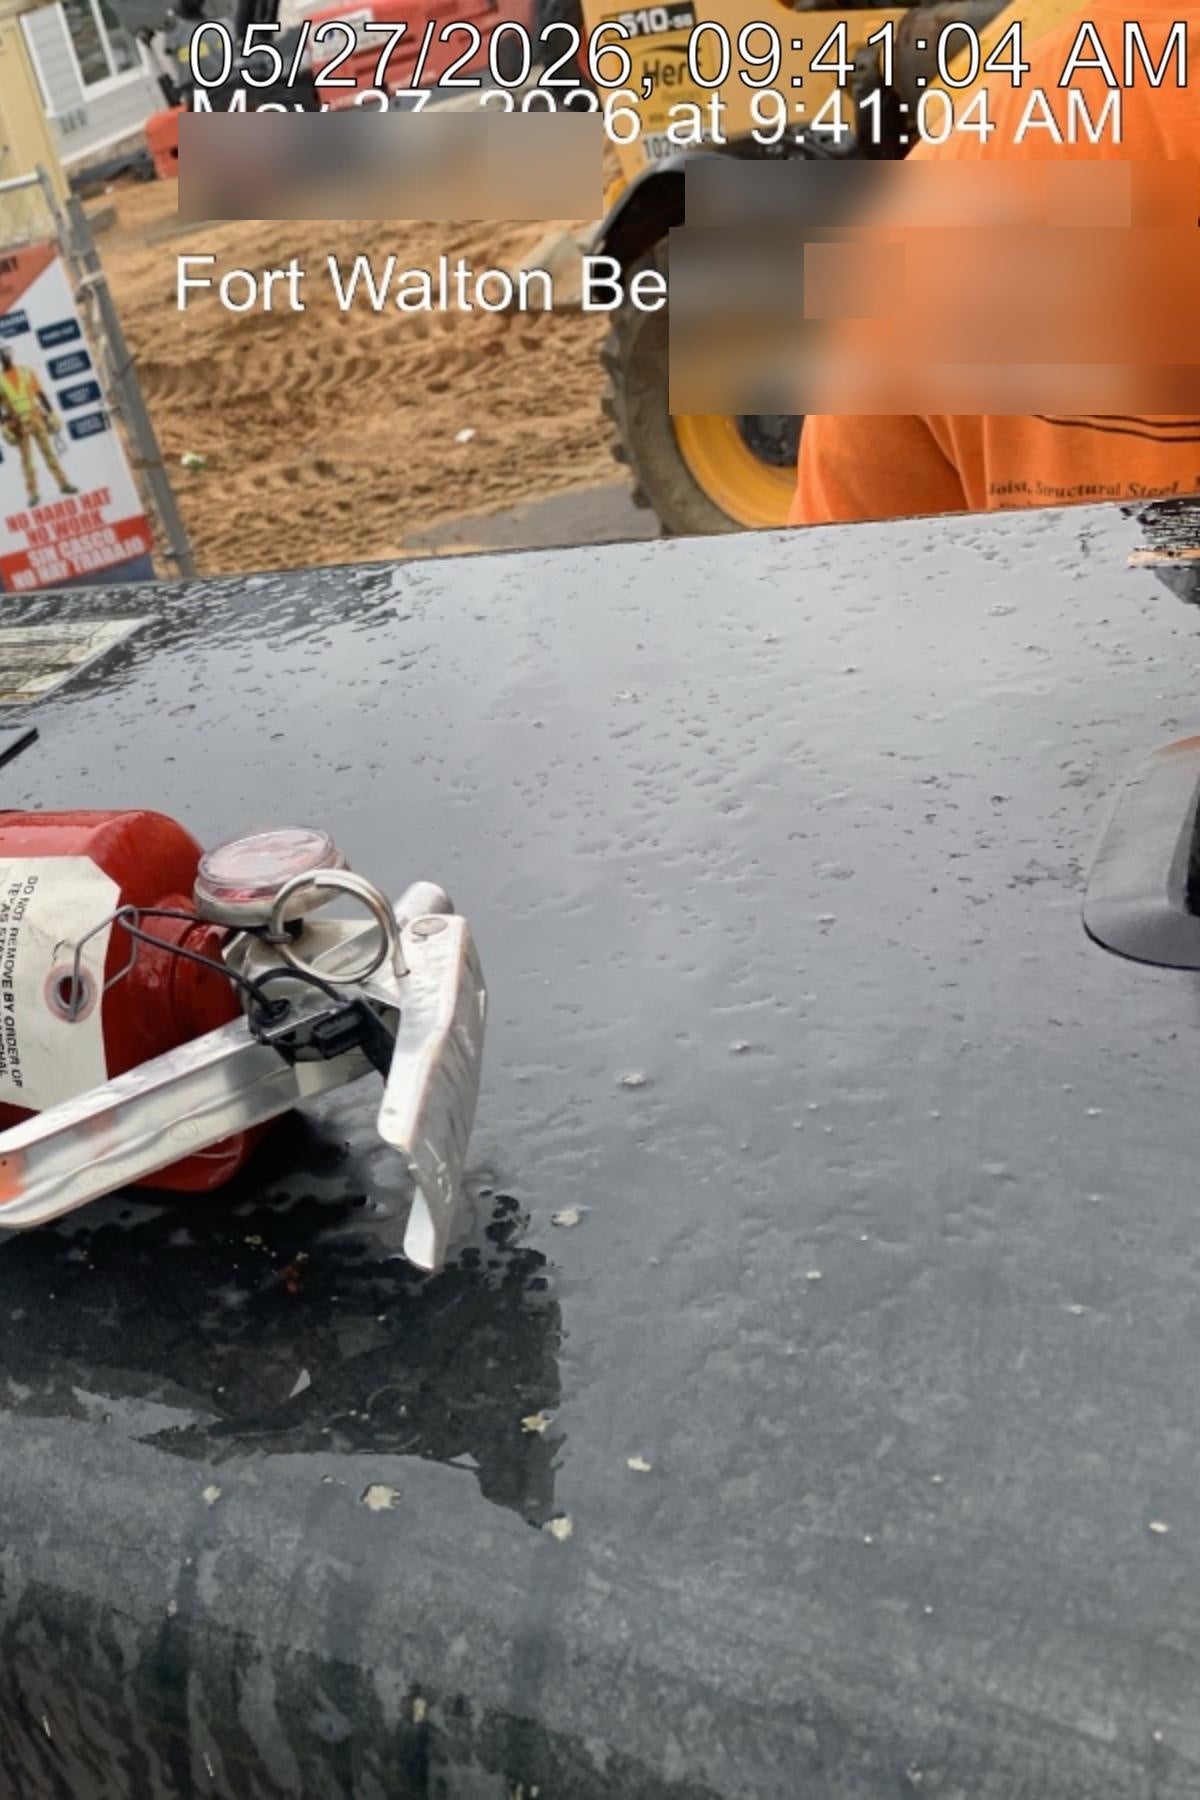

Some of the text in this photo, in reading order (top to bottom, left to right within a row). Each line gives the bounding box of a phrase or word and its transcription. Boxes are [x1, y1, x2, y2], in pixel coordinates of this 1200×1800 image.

[643, 57, 703, 87] Her
[1036, 480, 1120, 498] Structural
[23, 875, 39, 896] DO
[2, 927, 19, 989] REMOVE
[3, 992, 15, 1013] BY
[3, 1015, 20, 1066] ORDER
